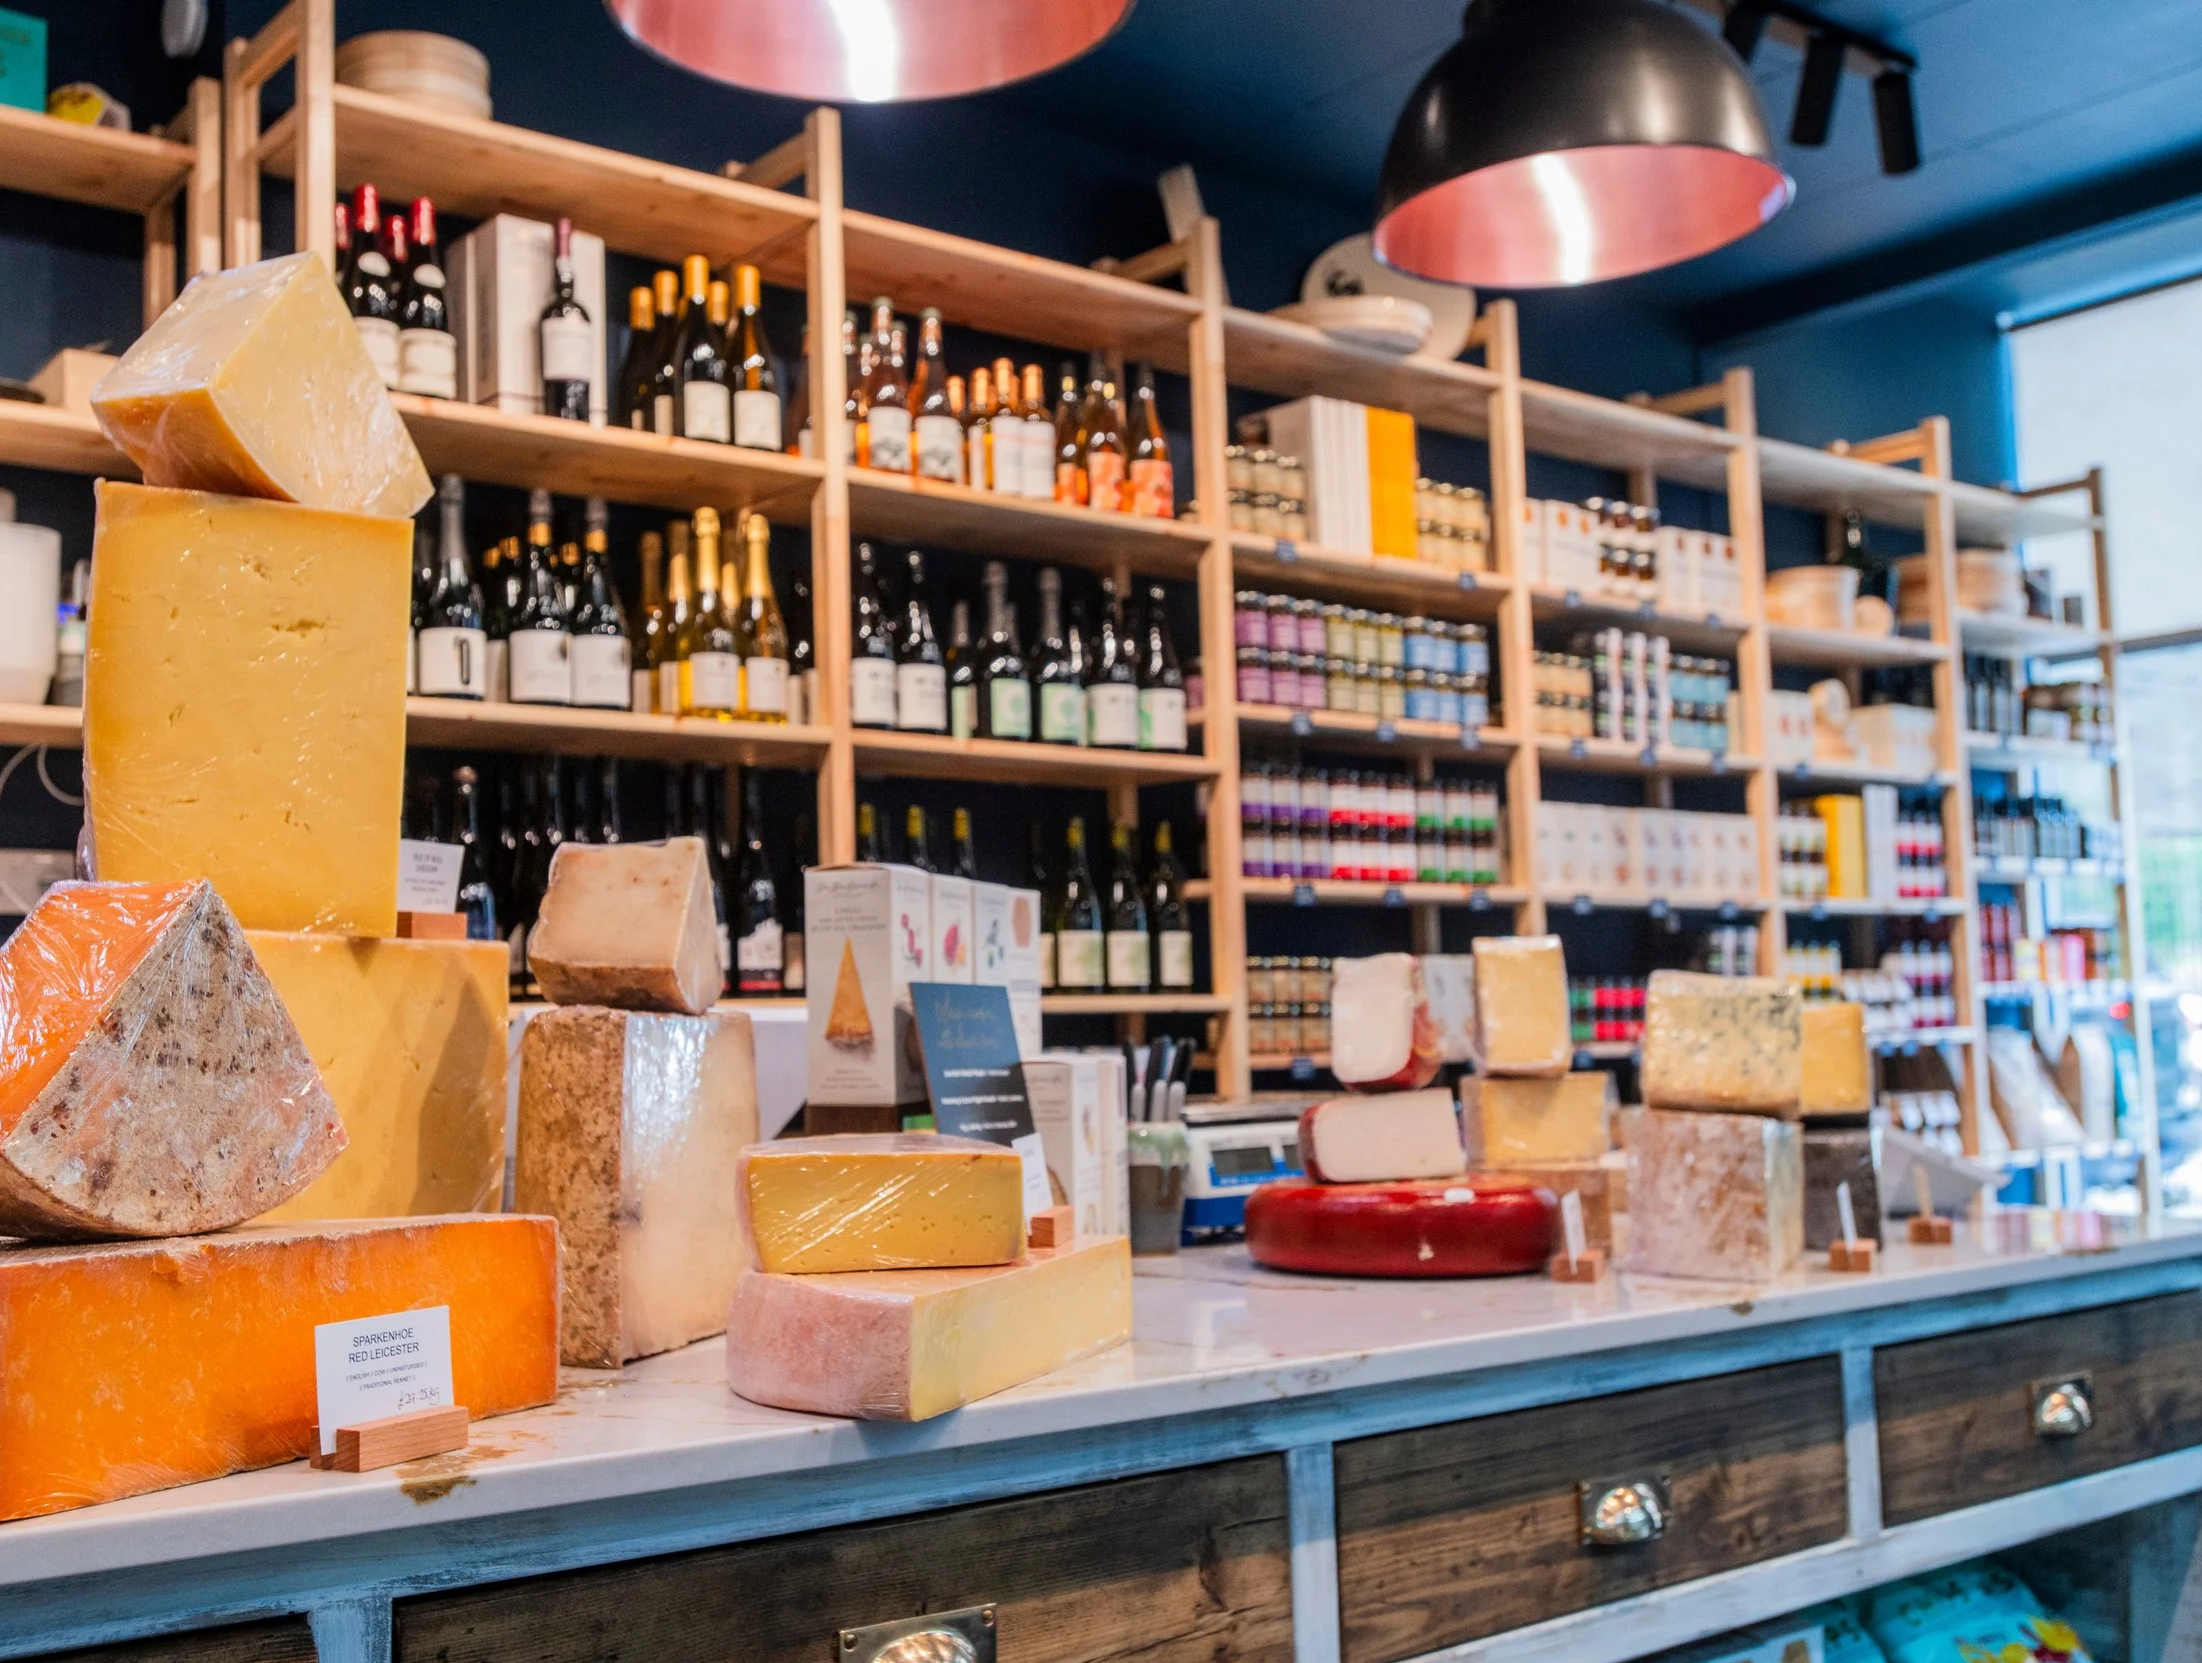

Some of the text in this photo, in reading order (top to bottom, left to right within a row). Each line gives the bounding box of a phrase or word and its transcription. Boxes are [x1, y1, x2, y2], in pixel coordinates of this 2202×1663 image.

[353, 1327, 414, 1347] SPARKENHOE
[348, 1342, 419, 1364] RED LEICESTER
